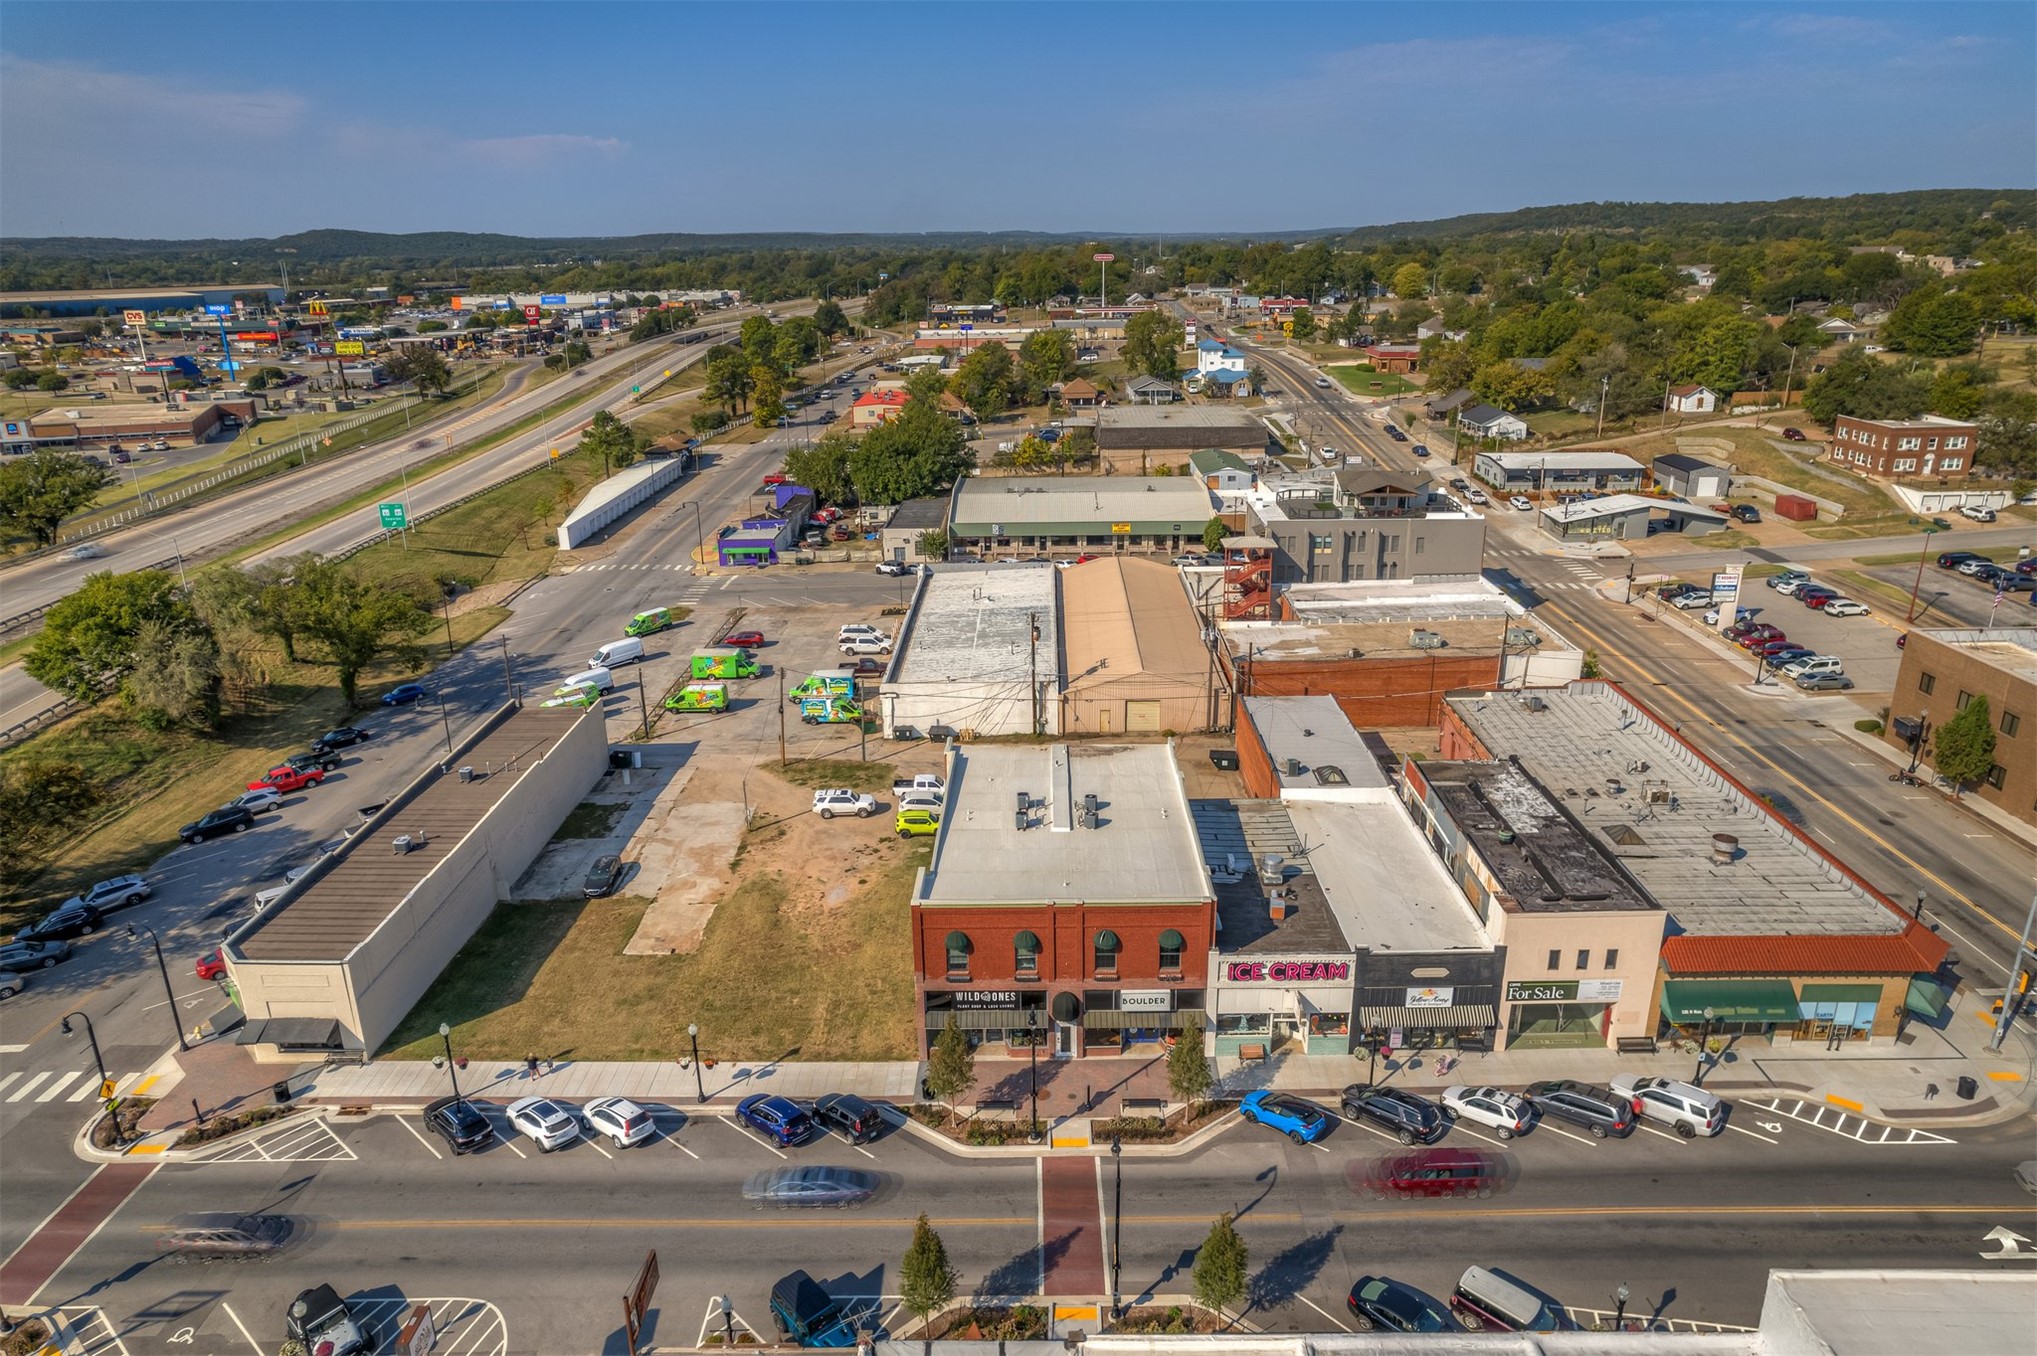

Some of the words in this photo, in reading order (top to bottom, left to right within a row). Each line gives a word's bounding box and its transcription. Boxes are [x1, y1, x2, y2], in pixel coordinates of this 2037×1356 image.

[126, 312, 143, 320] CVS
[1228, 963, 1263, 981] ICE
[1268, 962, 1348, 981] CREAM
[956, 992, 980, 1001] WILD
[992, 992, 1016, 1001] ONES
[1508, 987, 1532, 1000] For
[1533, 986, 1564, 999] Sale
[1122, 997, 1166, 1005] BOULDER
